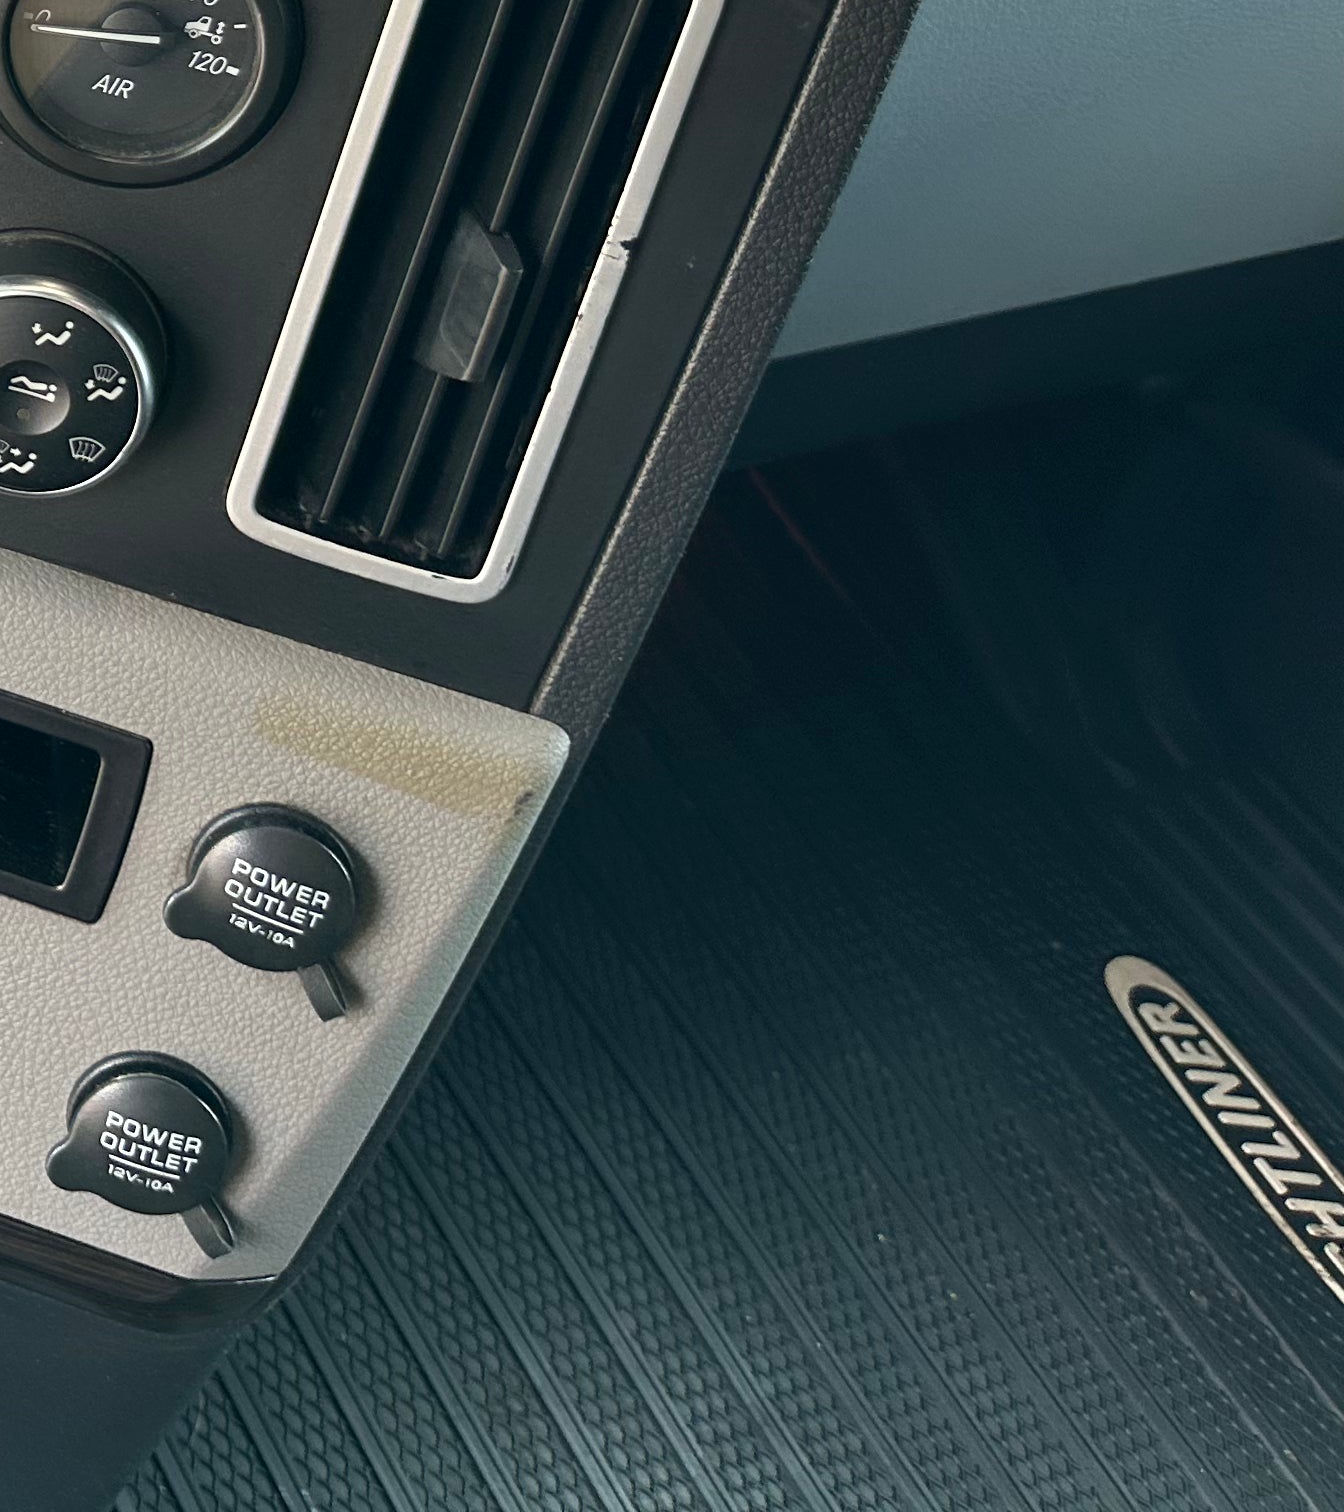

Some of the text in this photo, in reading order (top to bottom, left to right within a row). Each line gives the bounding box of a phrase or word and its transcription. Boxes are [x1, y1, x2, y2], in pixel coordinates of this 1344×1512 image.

[187, 50, 228, 76] 120
[91, 74, 135, 99] AIR
[224, 878, 325, 929] OUTLET
[231, 857, 331, 911] POWER
[229, 912, 296, 949] 12V-10A
[99, 1131, 198, 1175] OUTLET
[105, 1110, 203, 1156] POWER
[1138, 1001, 1344, 1275] HTLINER
[108, 1163, 175, 1194] 12V-10A
